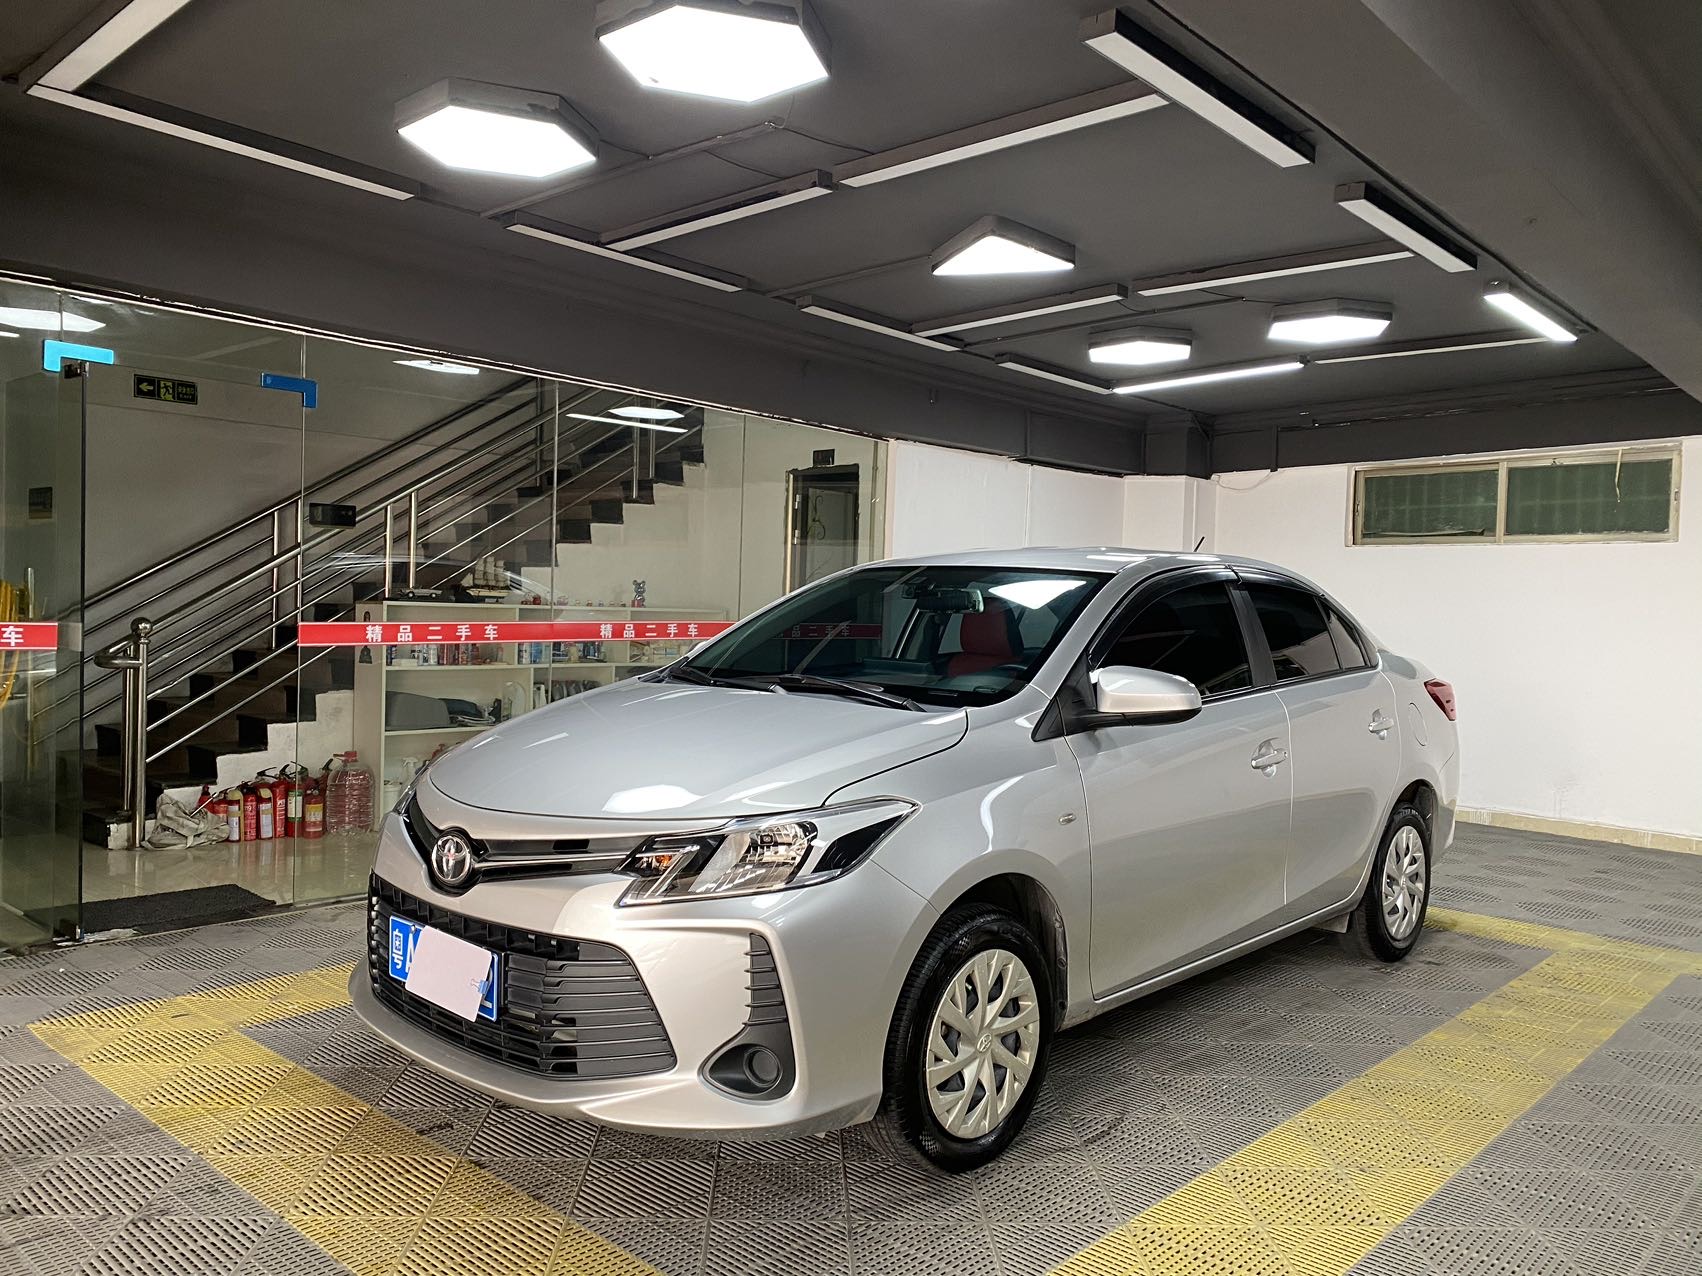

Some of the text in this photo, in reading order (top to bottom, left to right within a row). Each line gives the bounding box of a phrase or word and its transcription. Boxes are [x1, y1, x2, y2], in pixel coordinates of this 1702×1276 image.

[0, 626, 24, 647] 车
[366, 625, 498, 642] 精品二手车
[600, 624, 698, 638] 精品二手车
